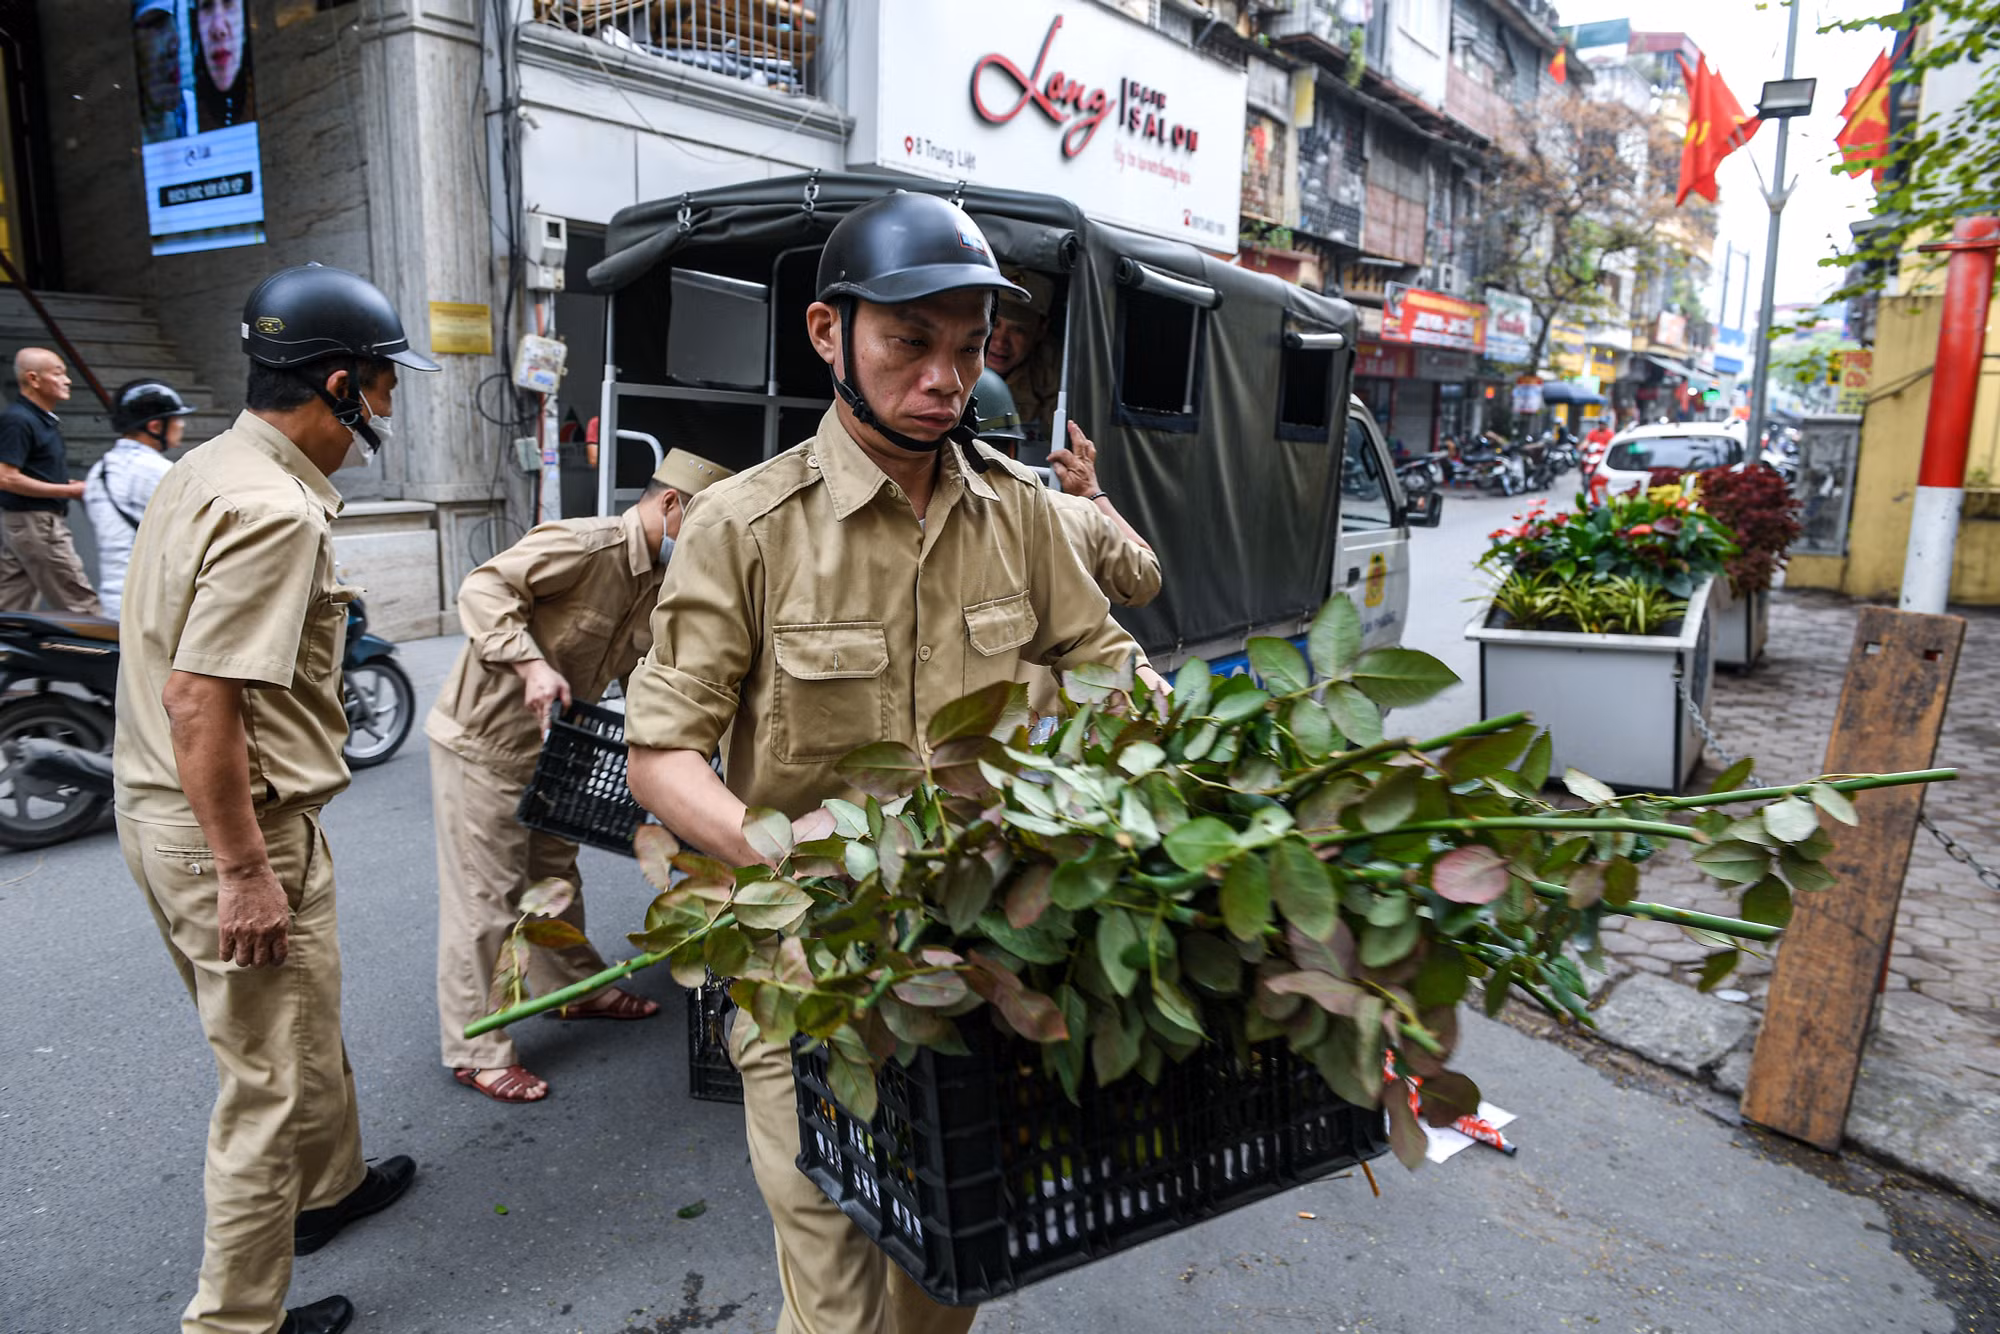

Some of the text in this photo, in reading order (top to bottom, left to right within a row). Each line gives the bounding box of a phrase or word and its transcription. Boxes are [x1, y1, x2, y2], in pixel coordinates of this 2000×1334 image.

[970, 13, 1117, 158] Long
[1129, 107, 1198, 152] SALON
[926, 139, 954, 168] Trung
